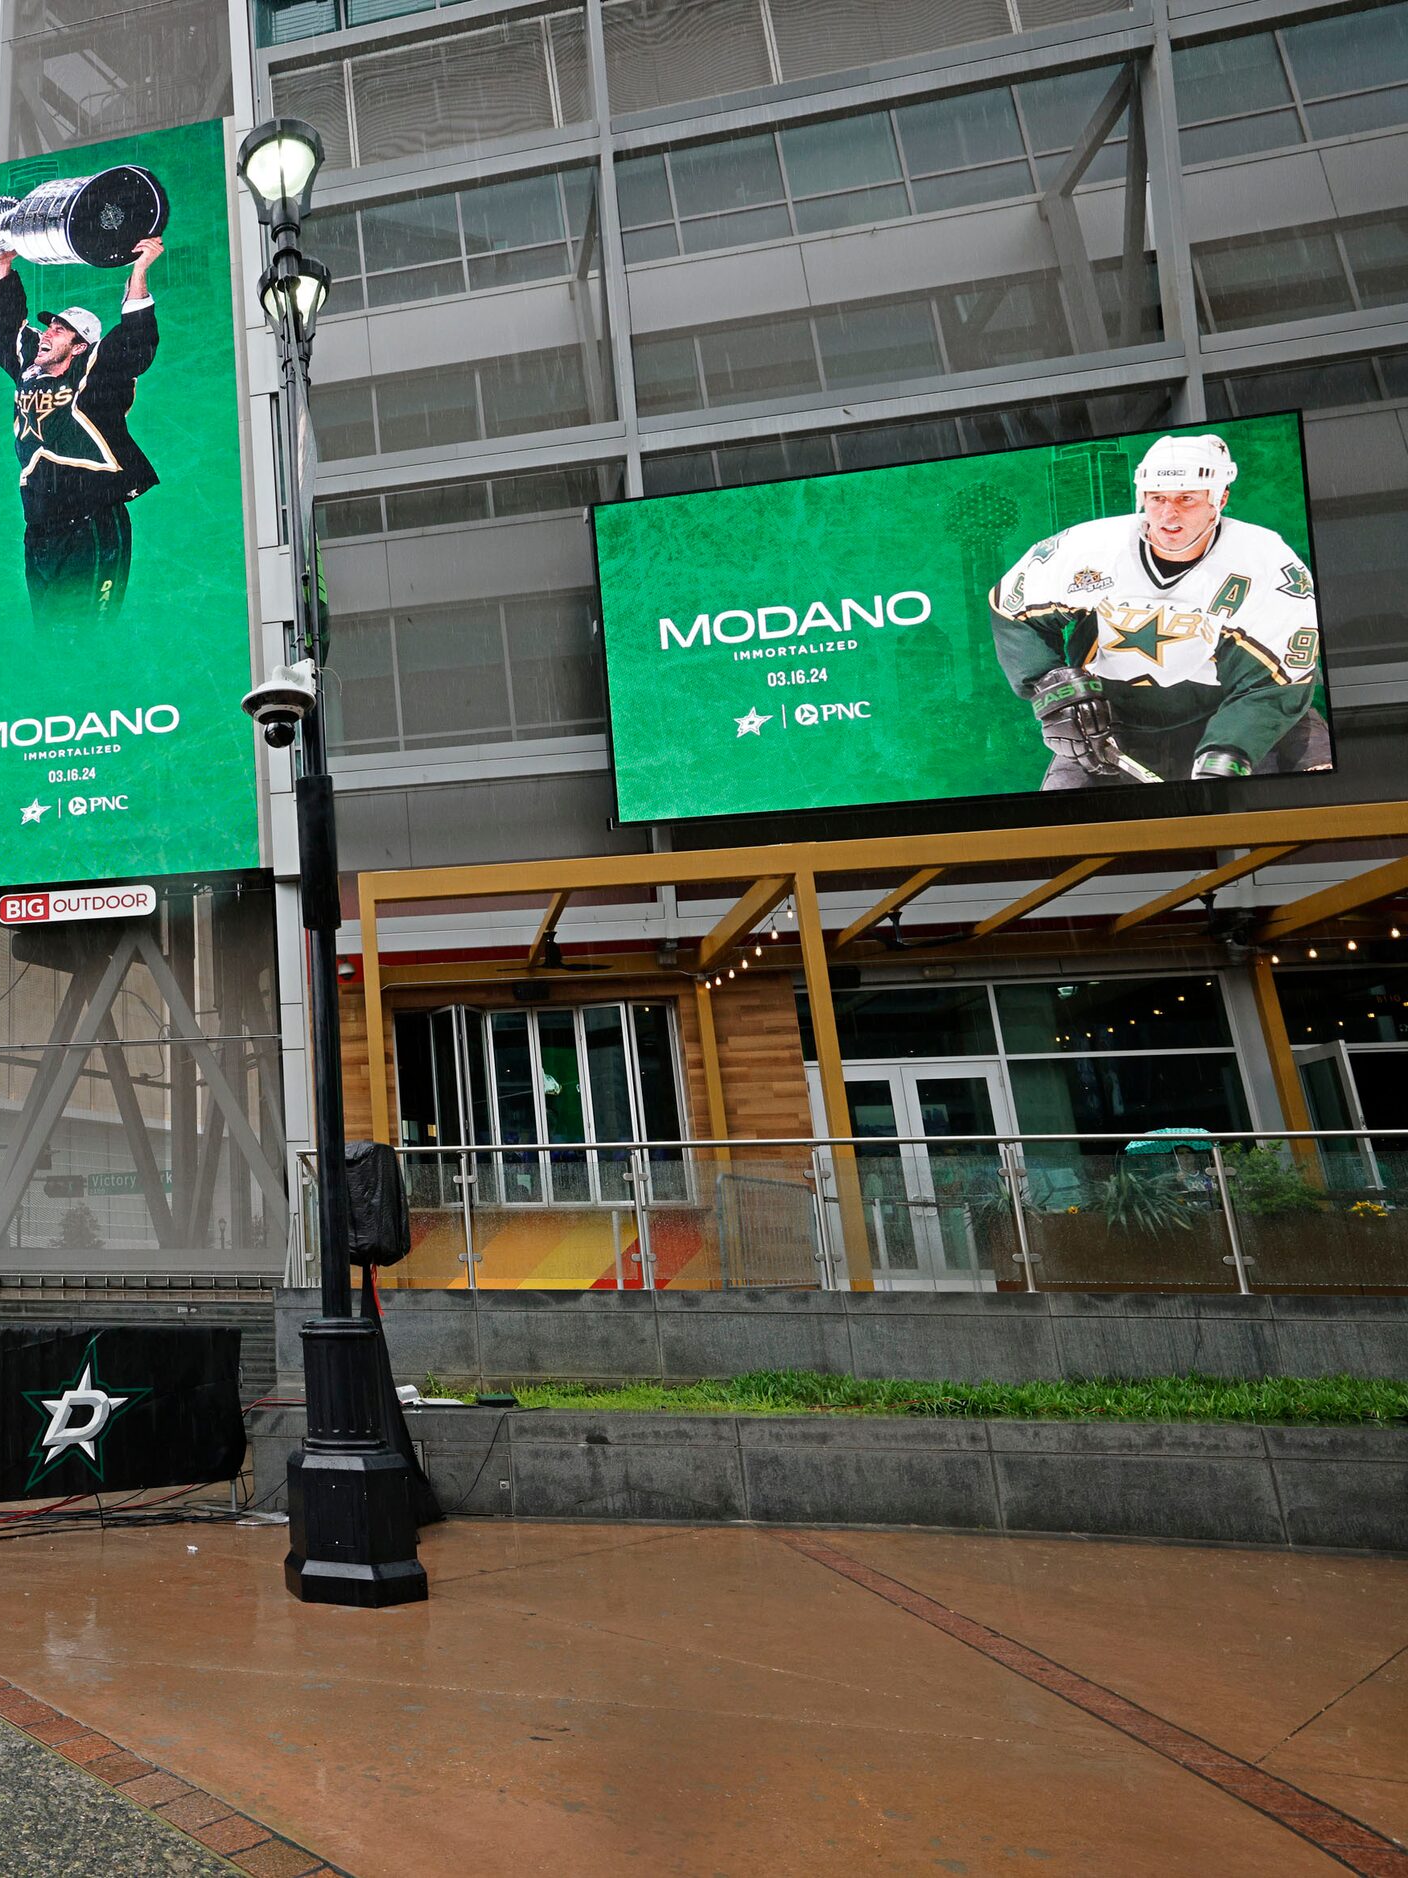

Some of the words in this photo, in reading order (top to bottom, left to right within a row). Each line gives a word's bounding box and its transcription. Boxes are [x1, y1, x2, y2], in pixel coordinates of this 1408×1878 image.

[1206, 573, 1252, 618] A
[659, 590, 931, 650] MODANO
[1096, 598, 1217, 645] STARS
[733, 639, 858, 661] IMMORTALIZED
[767, 667, 828, 687] 03.16.24
[820, 700, 872, 721] PNC
[23, 744, 122, 761] IMMORTALIZED
[48, 767, 97, 783] 03.16.24
[88, 794, 129, 812] PNC
[6, 898, 45, 919] BIG
[53, 893, 148, 912] OUTDOOR
[91, 1175, 137, 1188] Victory
[42, 1389, 110, 1446] D
